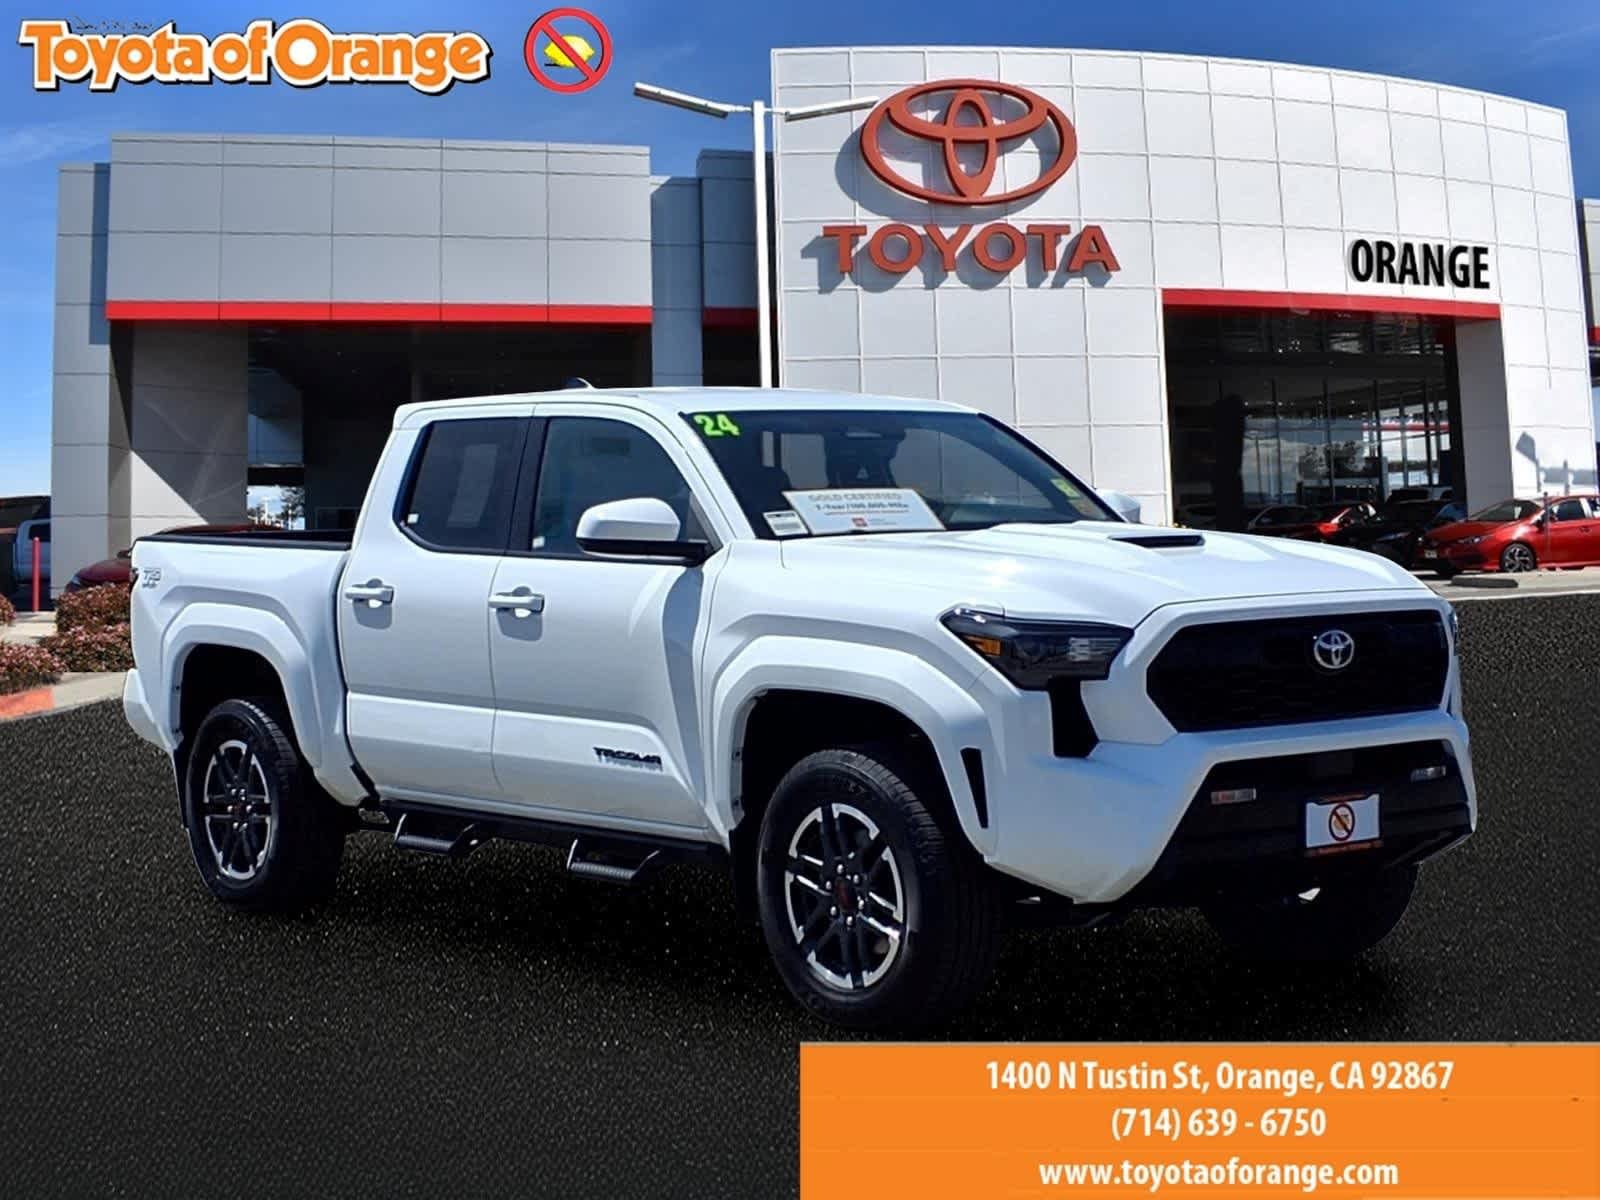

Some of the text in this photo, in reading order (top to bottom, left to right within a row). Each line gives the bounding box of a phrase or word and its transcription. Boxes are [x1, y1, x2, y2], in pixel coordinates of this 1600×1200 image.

[822, 223, 1120, 275] TOYOTA
[1350, 239, 1490, 290] ORANGE
[693, 413, 740, 436] 24
